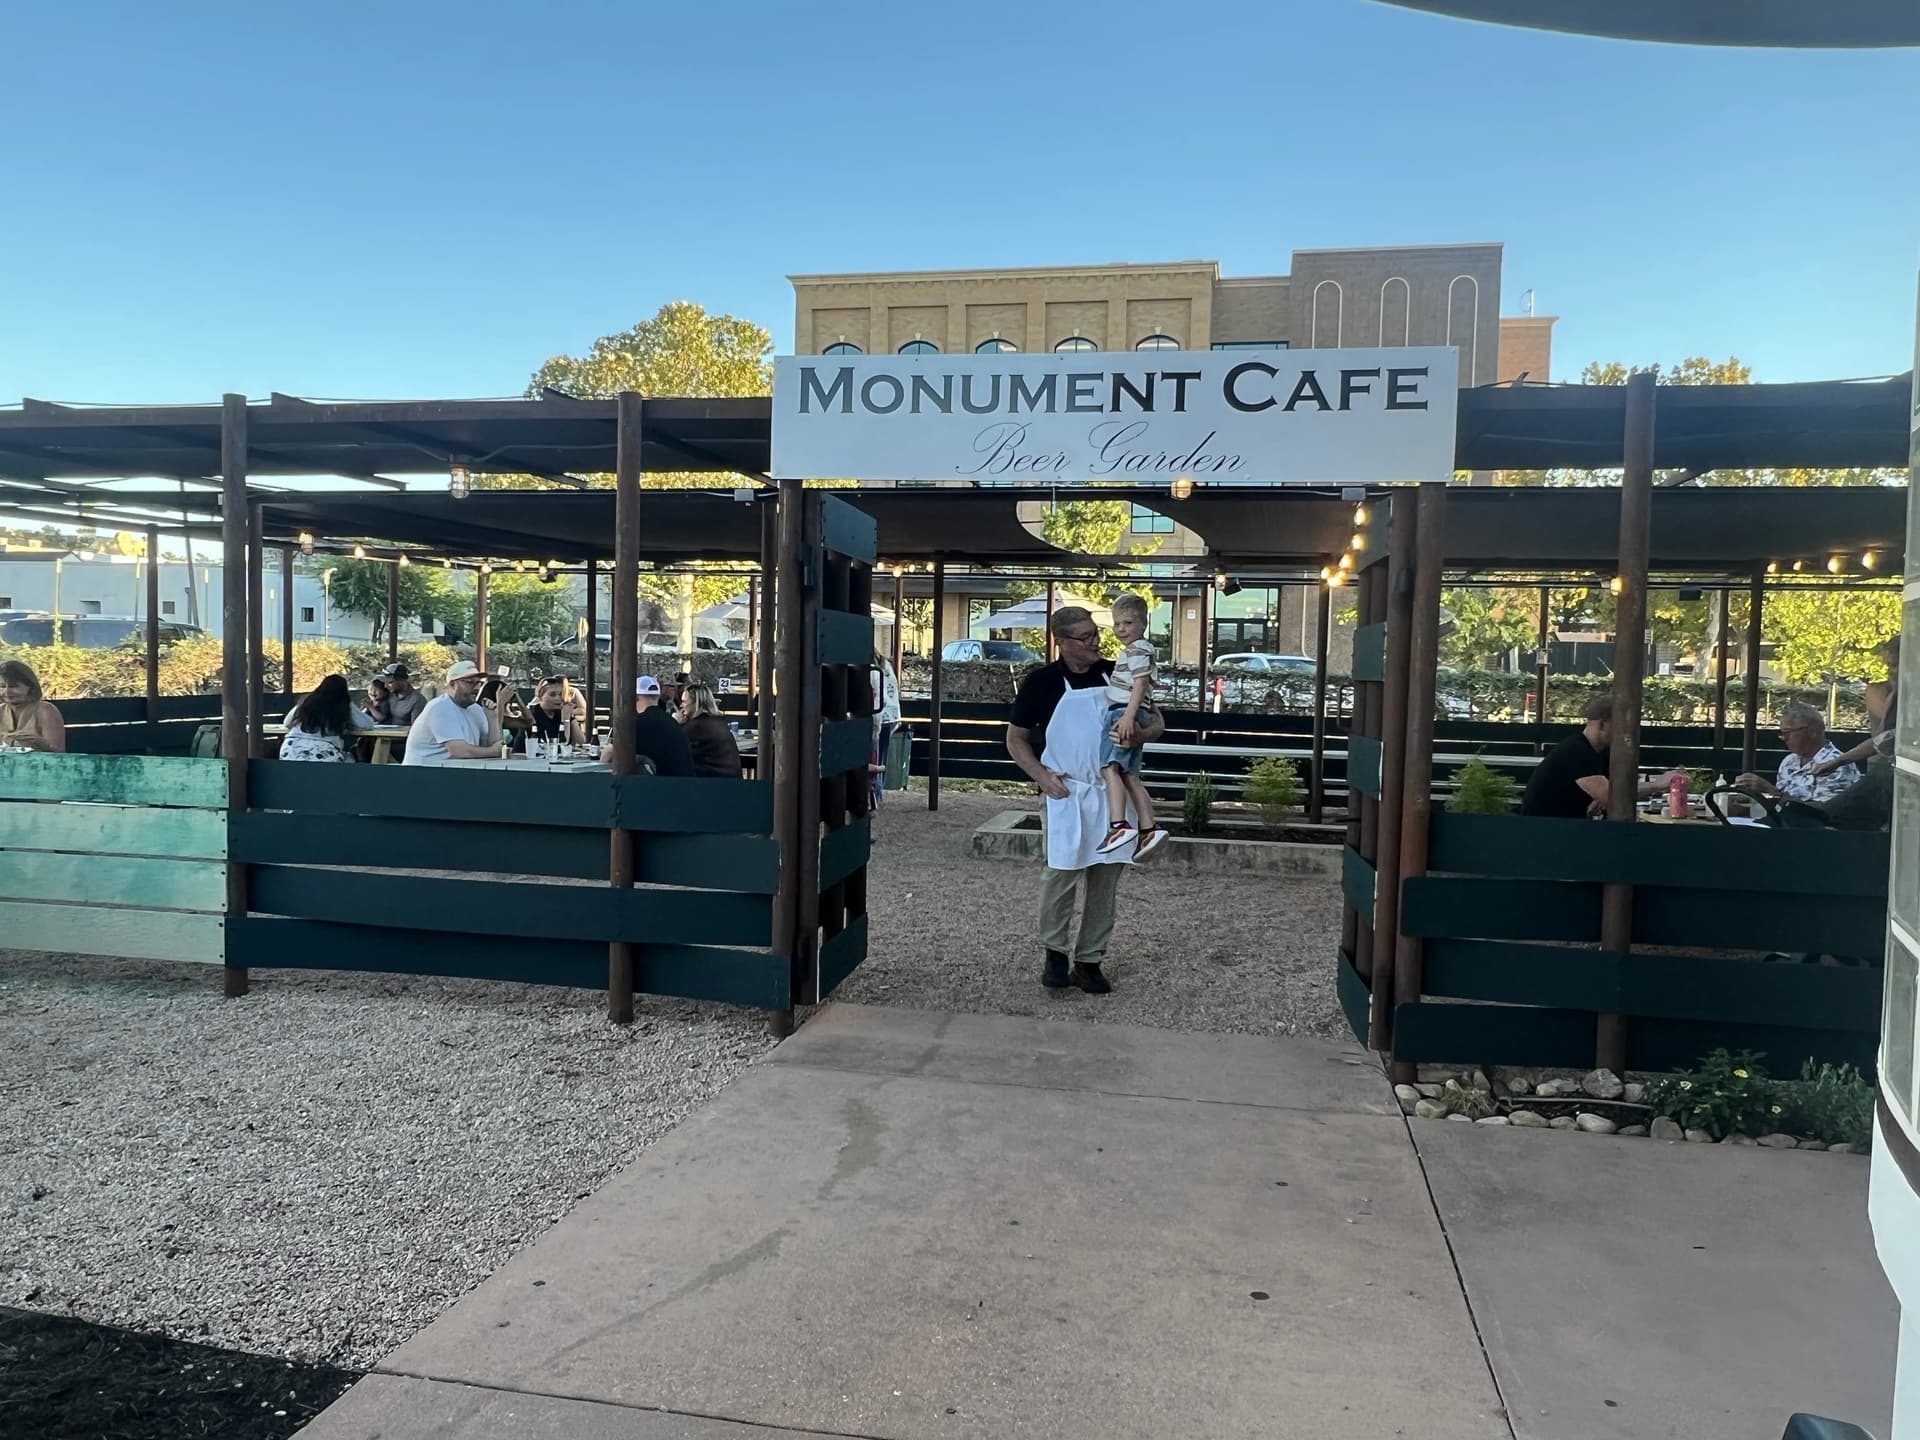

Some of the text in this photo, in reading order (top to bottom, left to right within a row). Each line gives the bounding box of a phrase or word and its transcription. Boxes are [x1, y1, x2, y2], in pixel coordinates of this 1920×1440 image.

[798, 361, 1429, 415] MONUMENT CAFE
[955, 420, 1247, 474] Beer Garden
